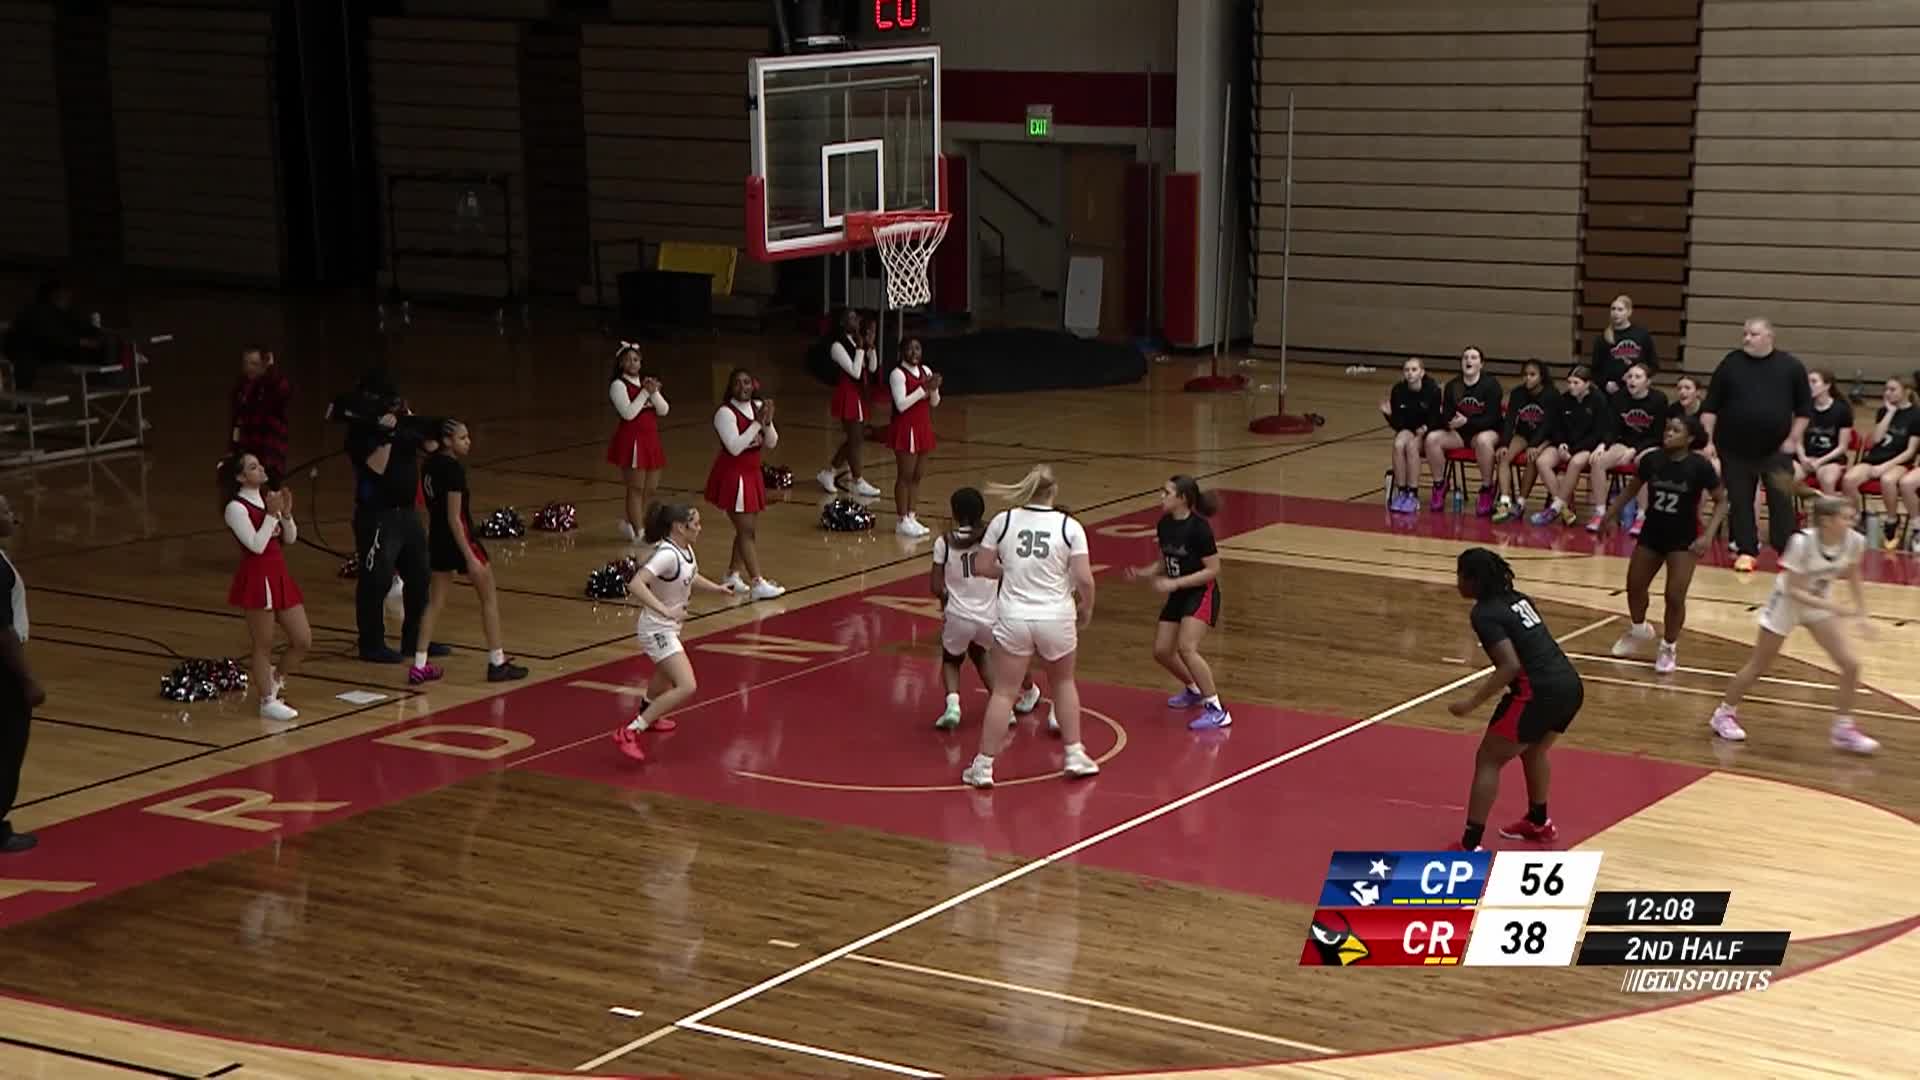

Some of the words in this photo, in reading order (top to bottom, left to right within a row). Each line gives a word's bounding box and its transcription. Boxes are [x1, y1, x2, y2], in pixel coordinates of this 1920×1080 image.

[1029, 119, 1047, 135] EXIT
[1653, 490, 1680, 513] 22
[1016, 529, 1052, 559] 35
[1510, 599, 1542, 629] 30
